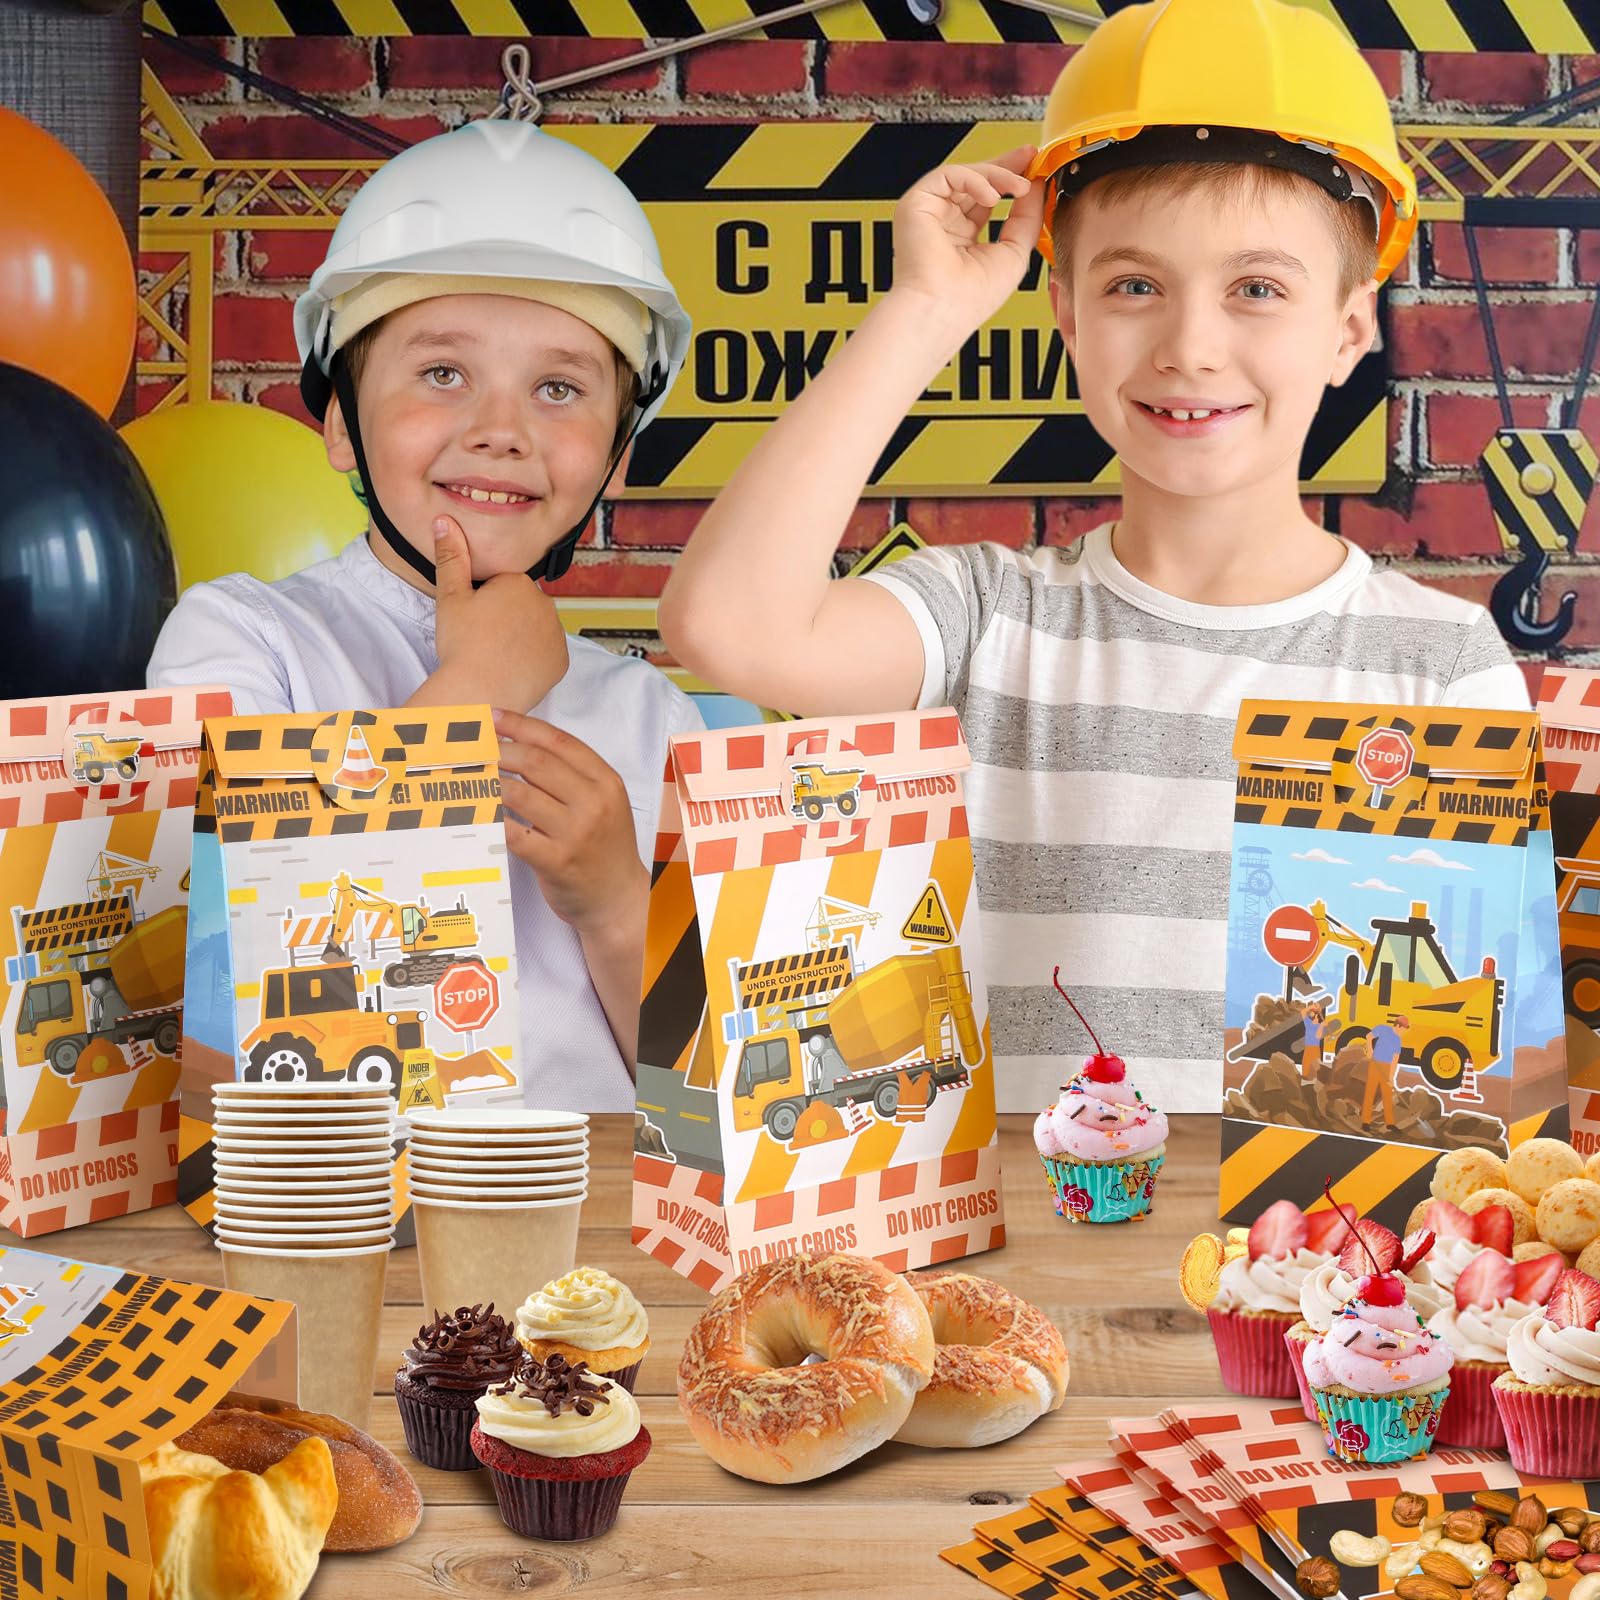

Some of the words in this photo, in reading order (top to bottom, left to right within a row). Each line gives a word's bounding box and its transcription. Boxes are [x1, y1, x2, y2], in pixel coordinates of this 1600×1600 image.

[1367, 748, 1404, 765] STOP
[903, 774, 957, 799] CROSS
[1236, 776, 1324, 802] WARNING!
[217, 790, 311, 817] WARNING!
[686, 800, 714, 827] DO
[714, 797, 750, 824] NOT
[29, 925, 60, 938] UNDER
[61, 912, 126, 931] CONSTRUCTION
[910, 922, 946, 937] WARNING
[746, 978, 777, 992] UNDER
[778, 963, 846, 985] CONSTRUCTION
[443, 987, 488, 1007] STOP
[408, 1062, 430, 1074] UNDER
[20, 1173, 45, 1201] DO
[47, 1164, 80, 1195] NOT
[83, 1152, 139, 1187] CROSS
[657, 1199, 680, 1224] DO
[675, 1205, 704, 1235] NOT
[886, 1210, 909, 1238] DO
[911, 1202, 942, 1232] NOT
[945, 1189, 998, 1224] CROSS
[738, 1246, 763, 1274] DO
[765, 1237, 798, 1263] NOT
[801, 1223, 858, 1253] CROSS
[102, 1275, 168, 1334] WARNING!
[41, 1338, 113, 1388] WARNING!
[1236, 1467, 1275, 1485] DO
[1271, 1461, 1322, 1480] NOT
[1188, 1485, 1227, 1503] DO
[1144, 1524, 1185, 1544] DO
